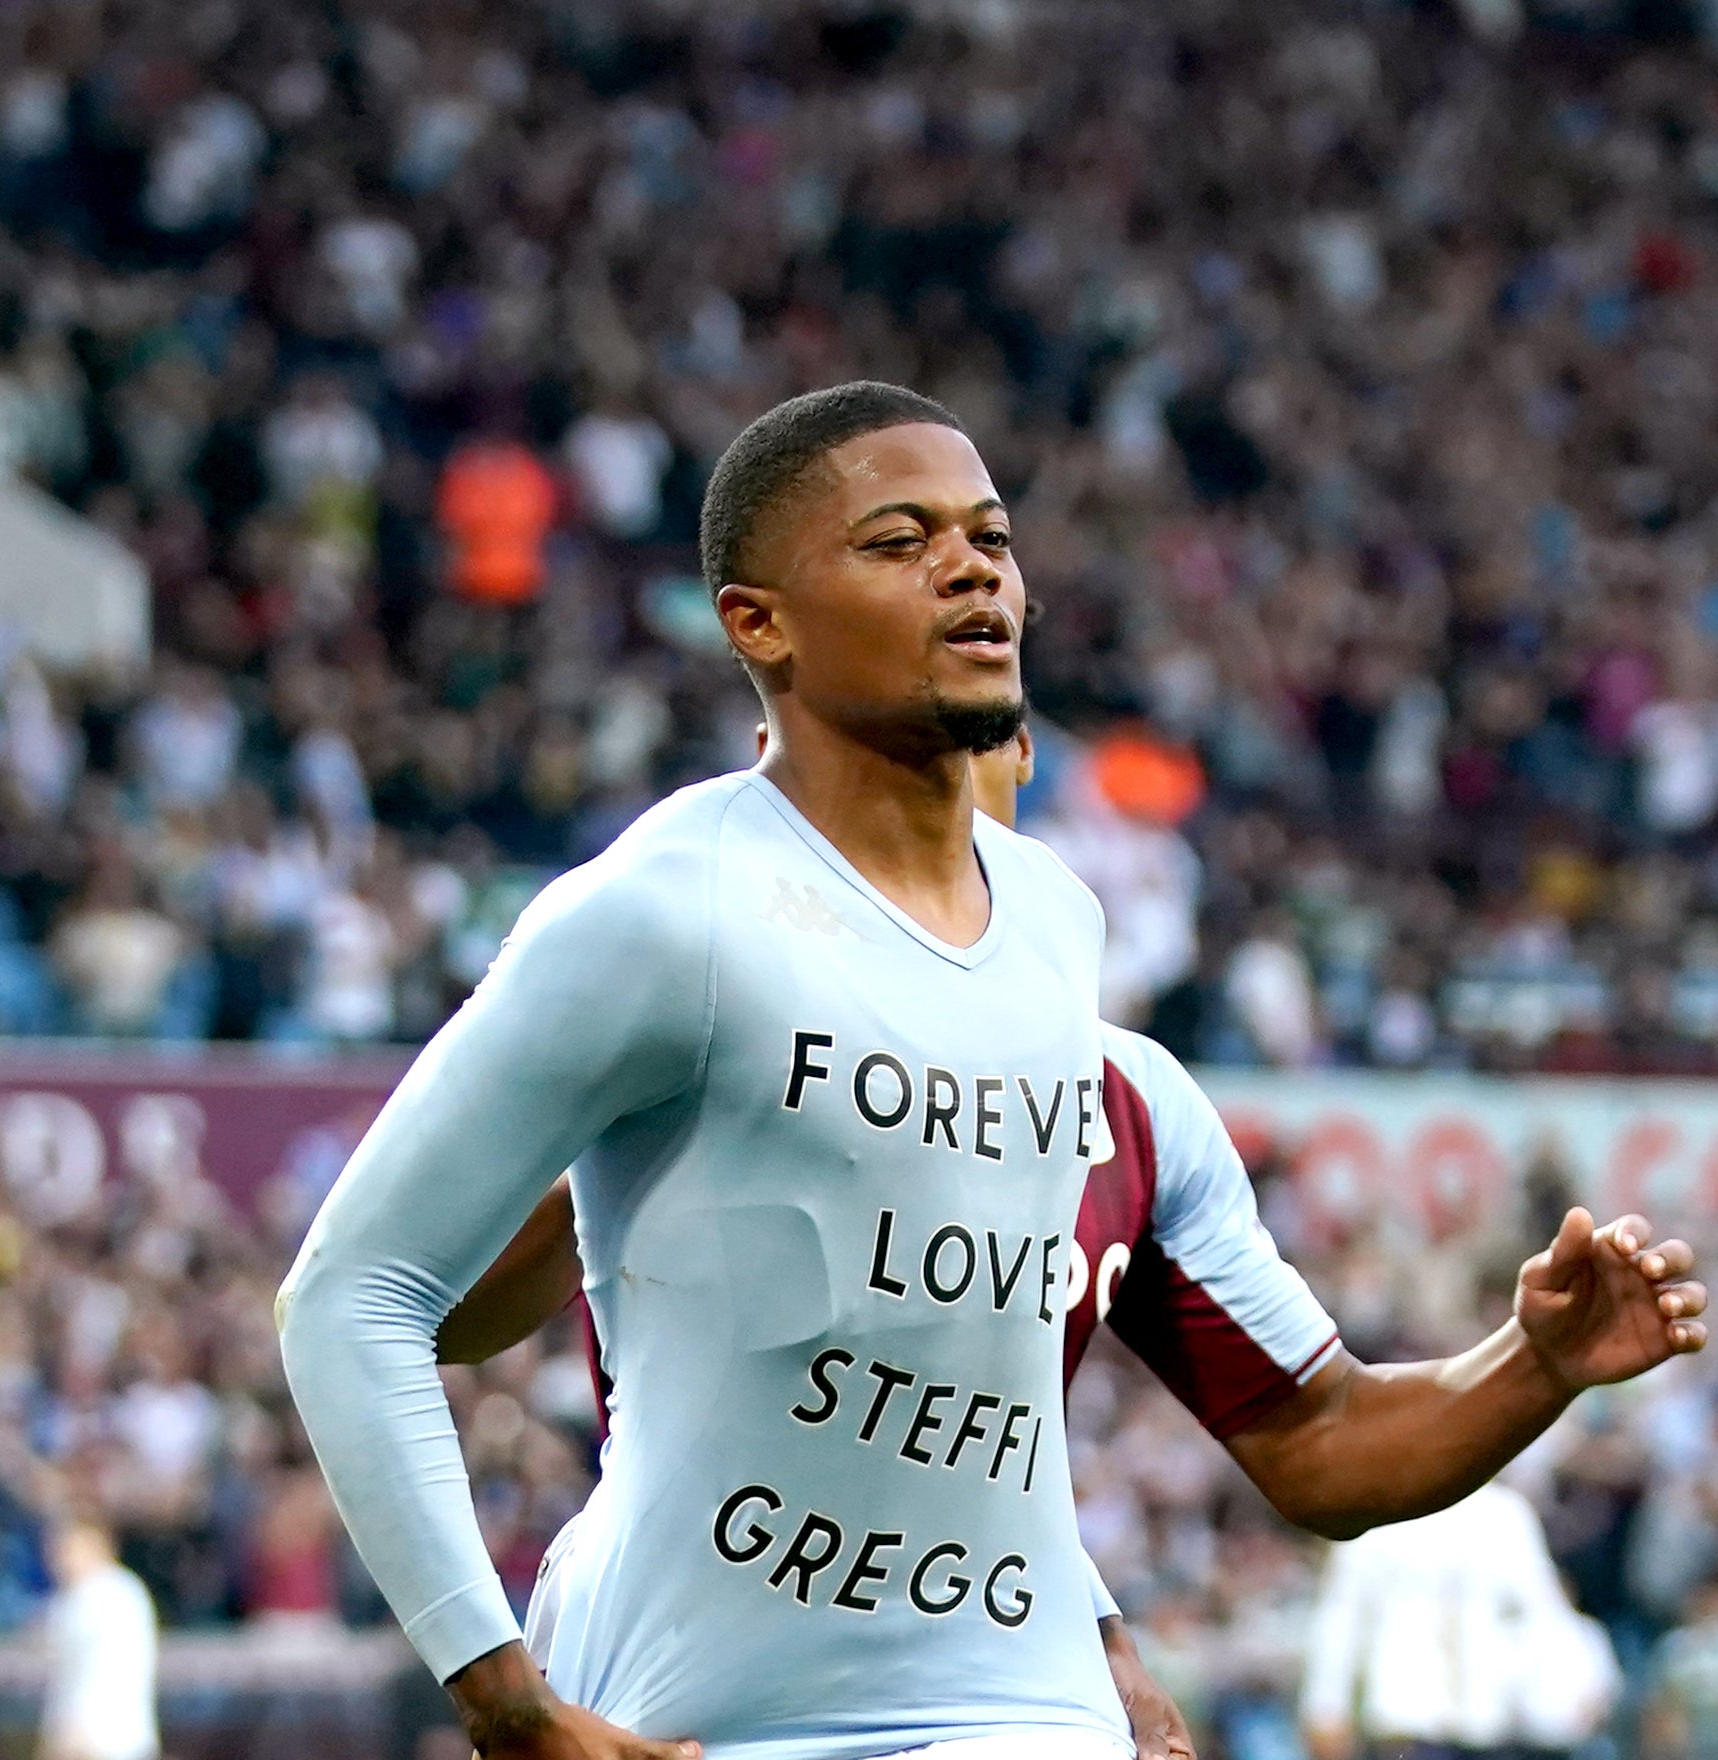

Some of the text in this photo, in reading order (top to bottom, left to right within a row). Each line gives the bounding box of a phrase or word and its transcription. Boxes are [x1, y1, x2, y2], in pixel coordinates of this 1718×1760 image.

[781, 1028, 1104, 1164] FOREVE
[867, 1207, 1062, 1327] LOVE
[789, 1346, 1042, 1495] STEFFI
[711, 1483, 1036, 1632] GREGG
